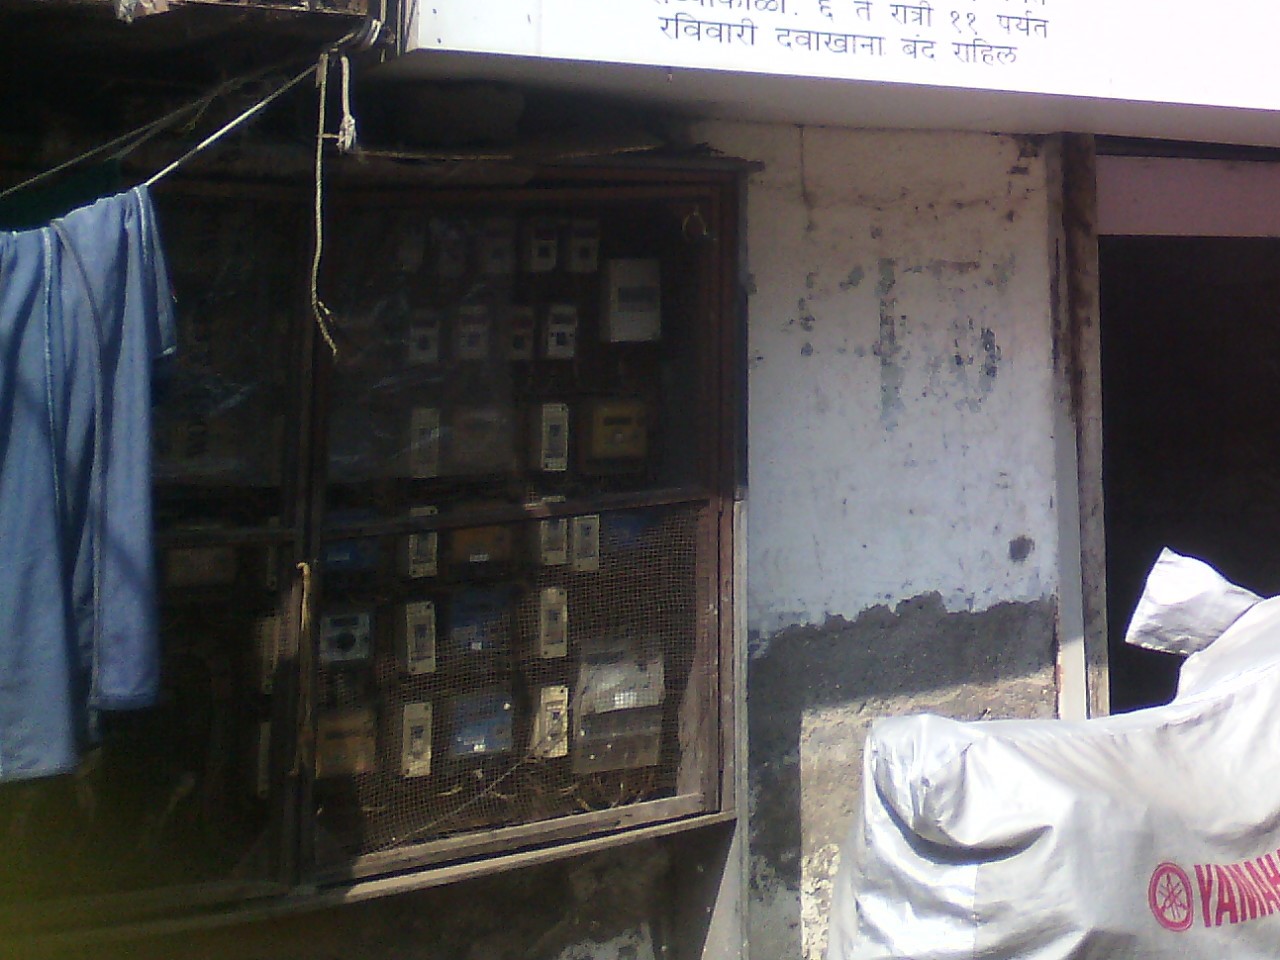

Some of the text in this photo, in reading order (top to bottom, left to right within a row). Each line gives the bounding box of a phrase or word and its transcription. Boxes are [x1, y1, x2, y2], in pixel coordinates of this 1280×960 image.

[658, 12, 758, 46] रविवारी
[900, 34, 937, 61] बंद
[951, 38, 1018, 65] राहिल
[890, 0, 934, 27] रात्री
[950, 10, 979, 36] ११
